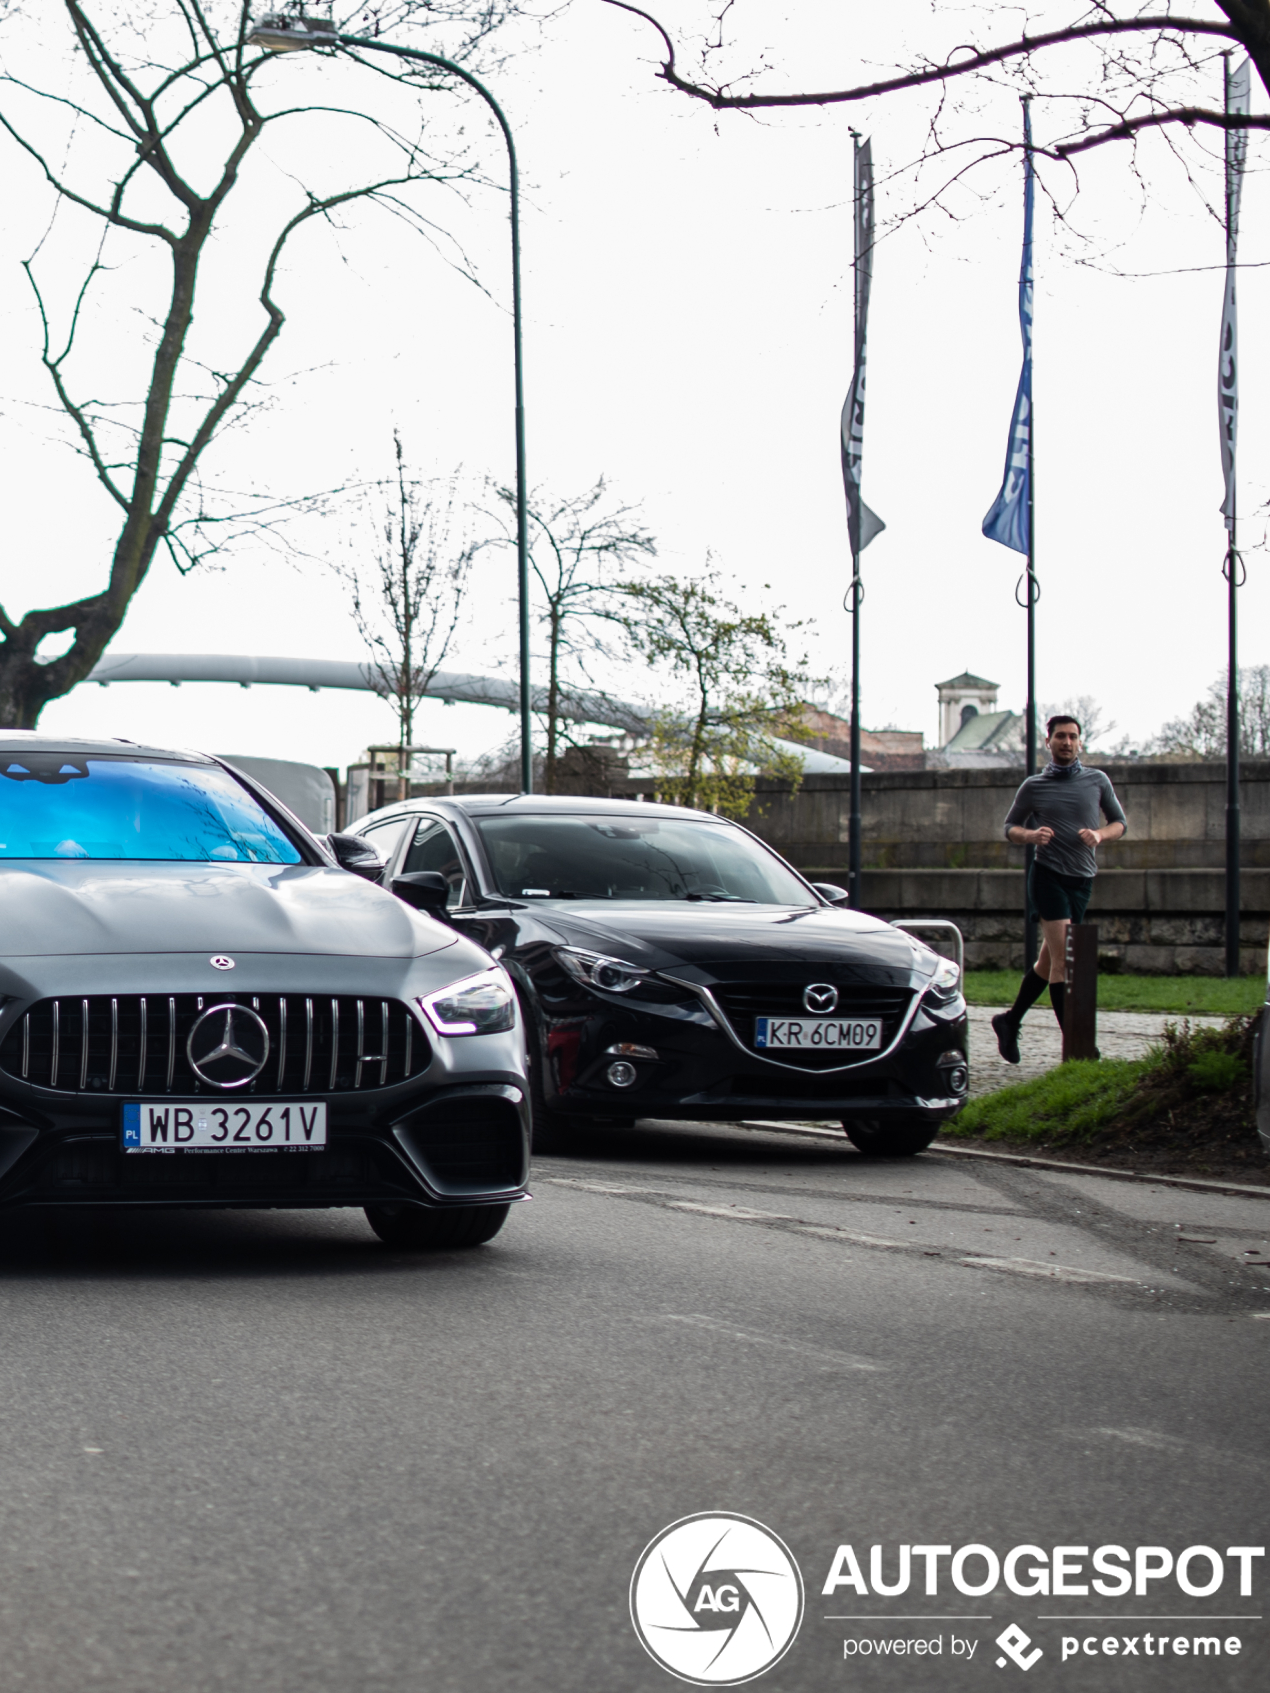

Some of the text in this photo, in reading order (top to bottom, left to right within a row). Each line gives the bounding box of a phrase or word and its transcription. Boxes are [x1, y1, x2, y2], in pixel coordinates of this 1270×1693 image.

[770, 1021, 877, 1046] KR 6CM09
[125, 1130, 139, 1140] PL
[148, 1106, 318, 1143] WB 3261V
